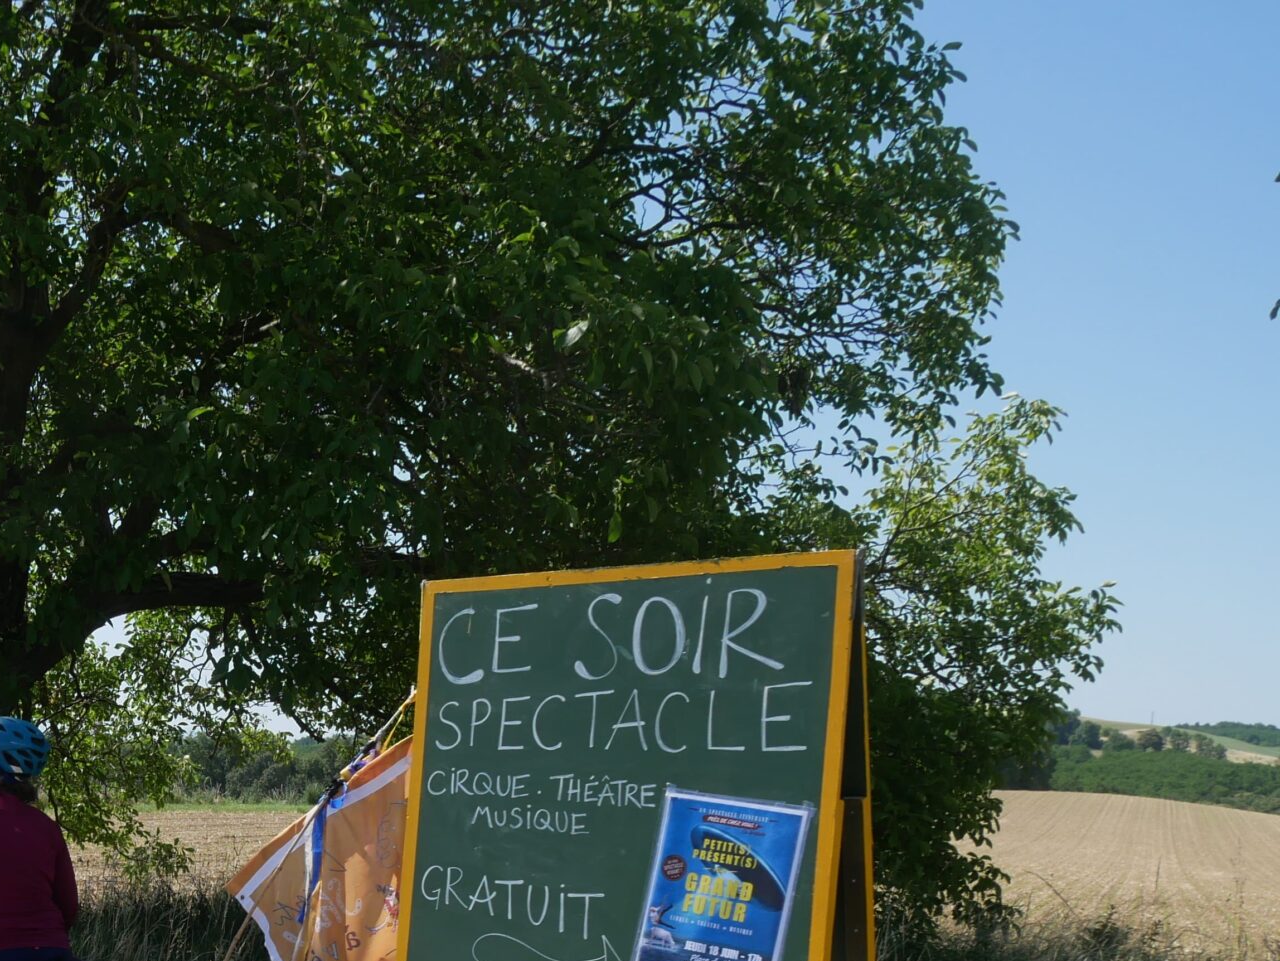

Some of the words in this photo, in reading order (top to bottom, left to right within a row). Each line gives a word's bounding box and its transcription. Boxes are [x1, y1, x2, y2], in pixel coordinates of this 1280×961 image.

[438, 602, 539, 685] CE
[435, 680, 813, 753] SPECTACLE
[692, 848, 757, 869] PRÉSENT(S)
[685, 872, 753, 901] GRAND
[682, 893, 747, 923] FUTUR
[684, 940, 707, 954] JEUDI
[720, 947, 740, 960] JUIN
